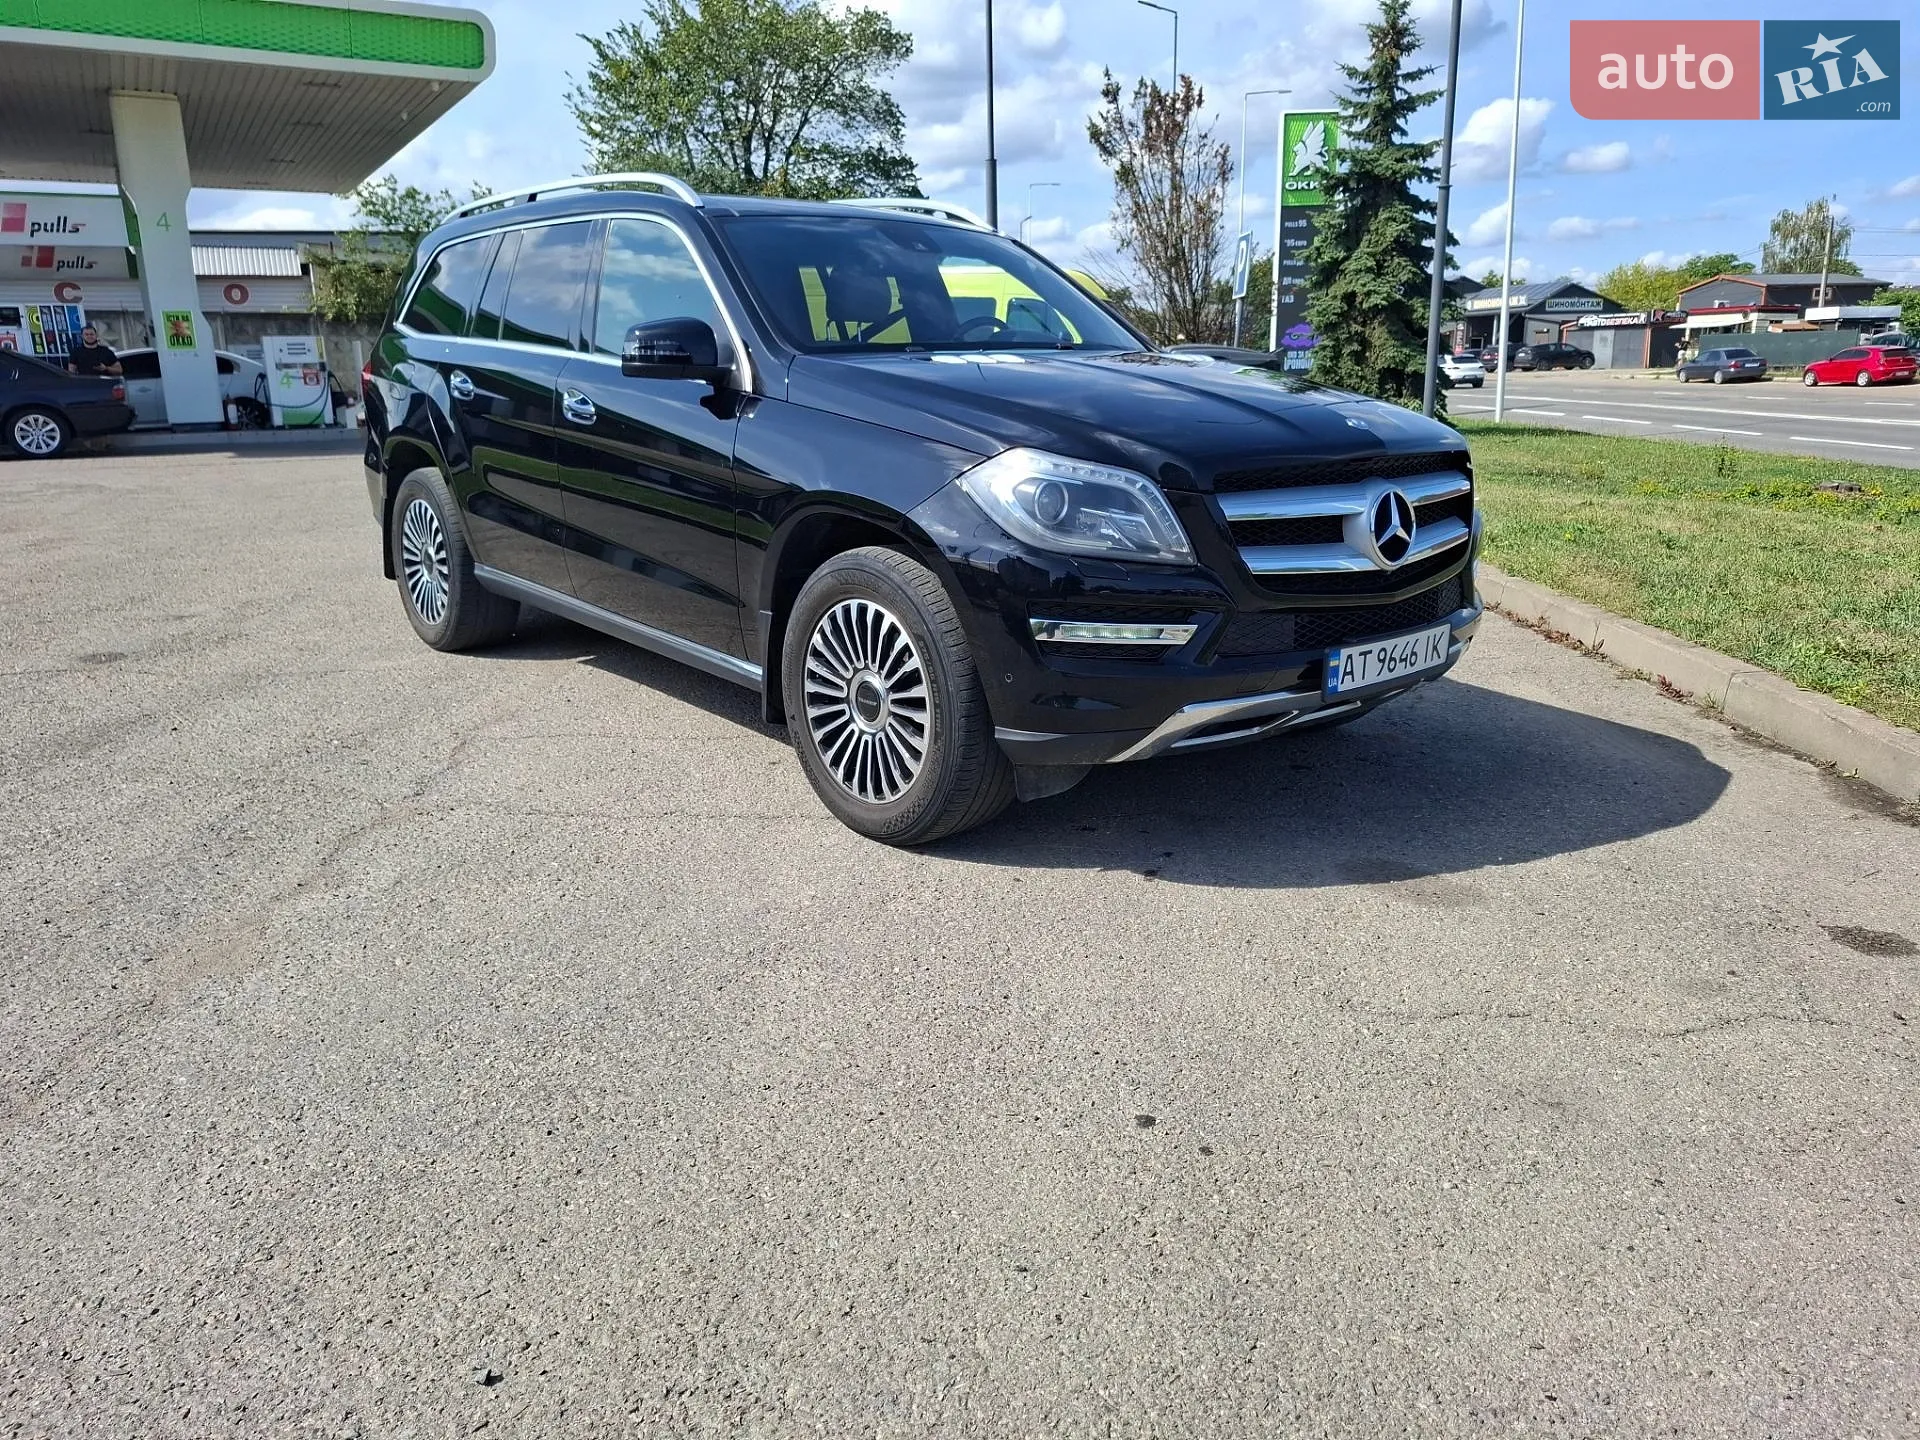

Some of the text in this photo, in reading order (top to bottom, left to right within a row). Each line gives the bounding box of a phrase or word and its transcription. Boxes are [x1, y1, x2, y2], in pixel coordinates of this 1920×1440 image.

[1285, 181, 1320, 190] OKK
[30, 216, 86, 238] pulls
[156, 212, 171, 231] 4
[56, 256, 98, 272] pulls
[1547, 299, 1602, 309] ШИНОМОНТАЖ
[279, 371, 293, 389] 4
[1328, 631, 1445, 687] UA AT 9646 IK
